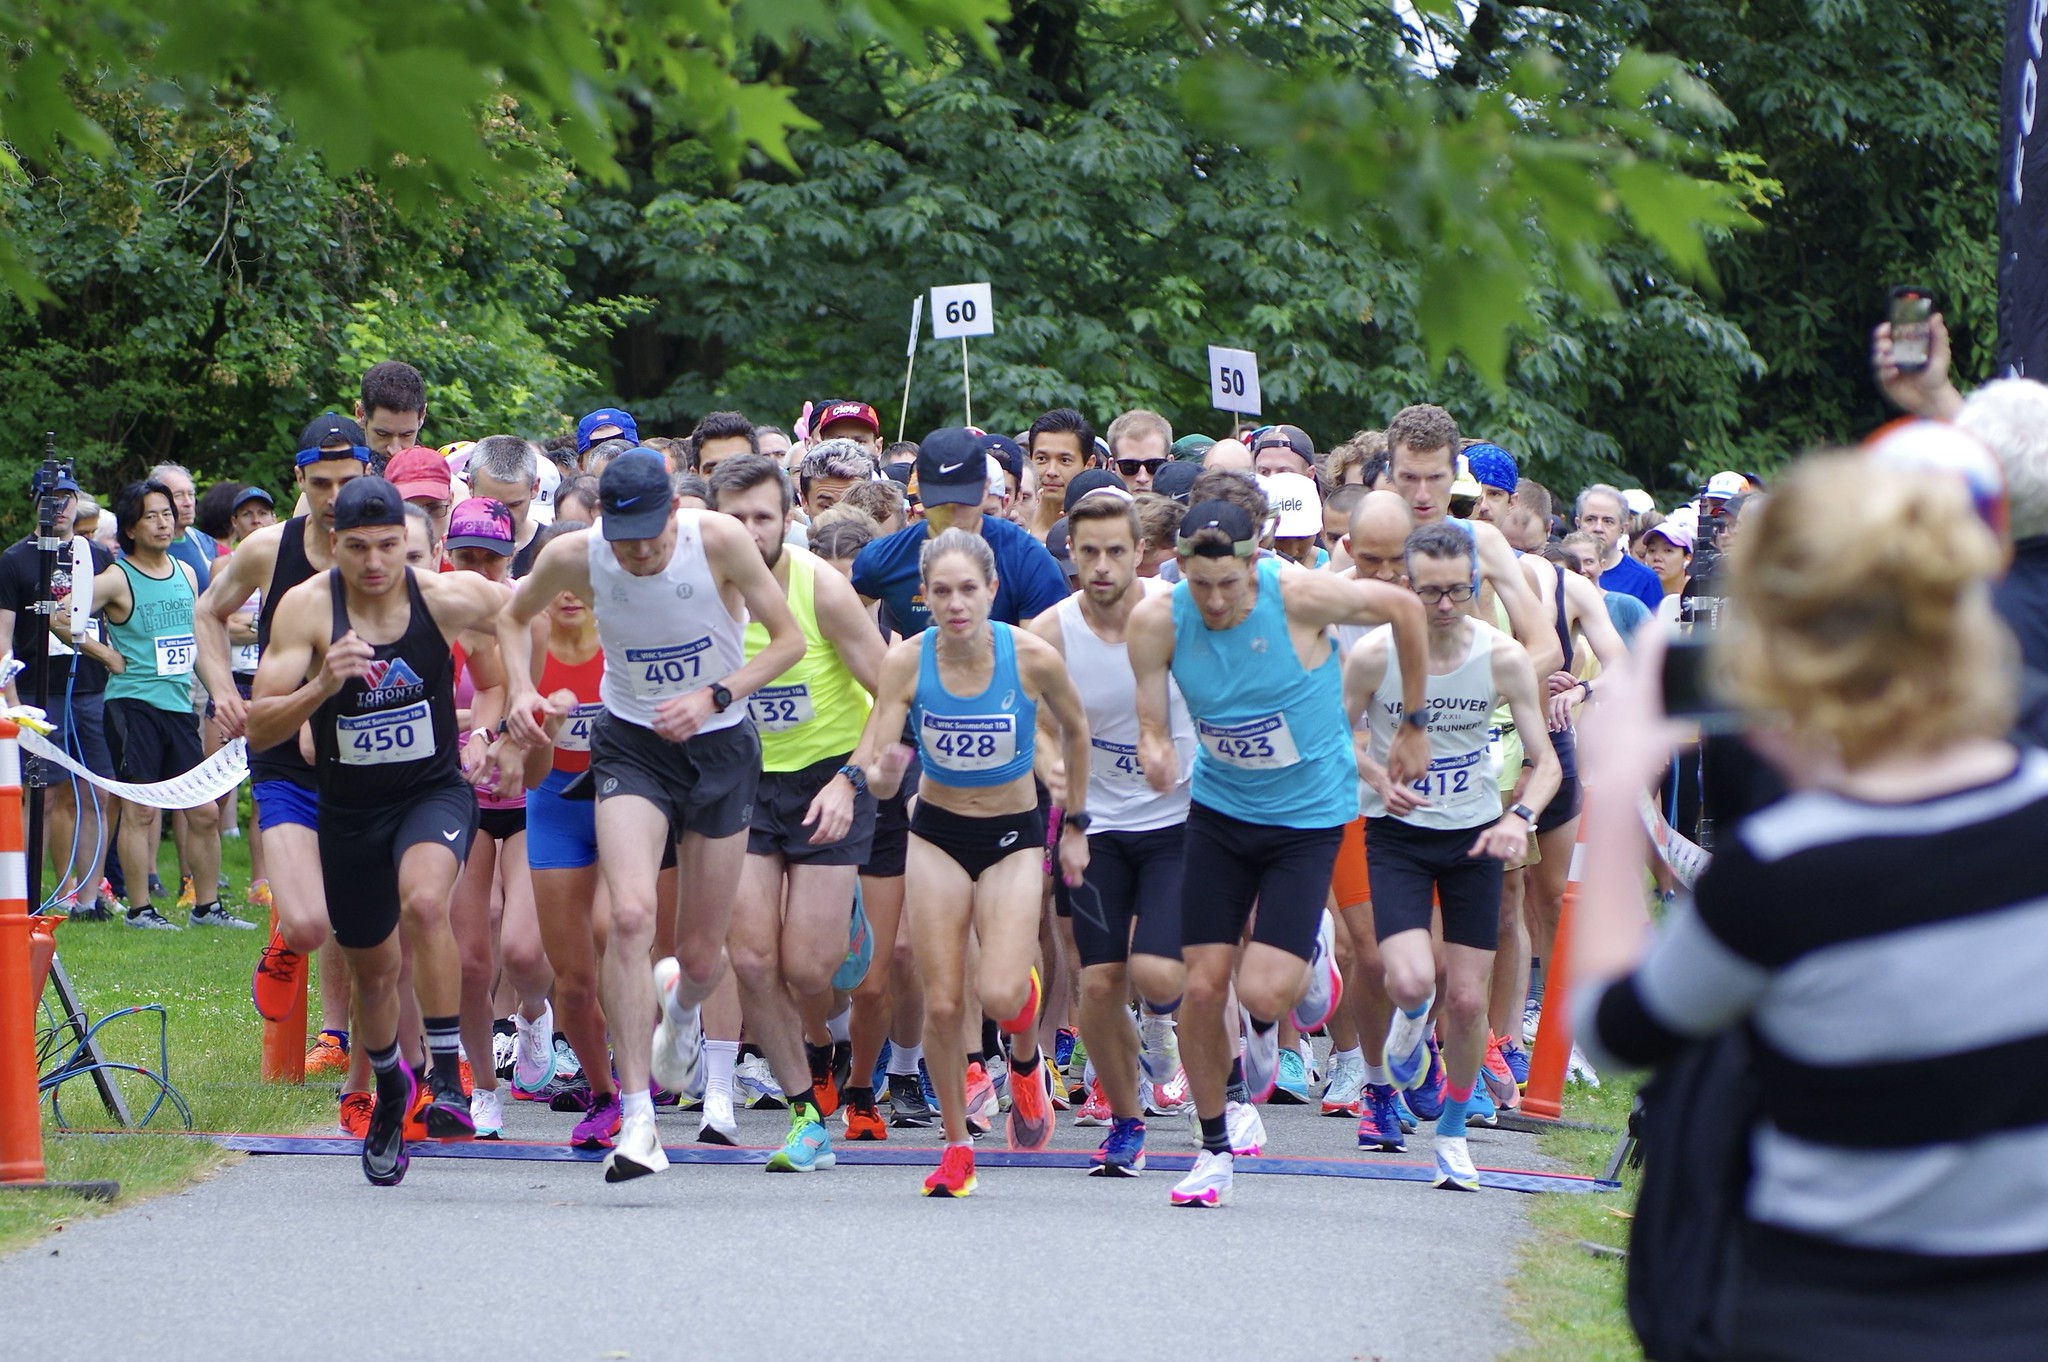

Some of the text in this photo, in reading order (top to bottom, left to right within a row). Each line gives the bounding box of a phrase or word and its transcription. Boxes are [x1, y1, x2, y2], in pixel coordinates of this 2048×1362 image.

[945, 299, 976, 323] 60
[1220, 367, 1245, 396] 50
[1280, 498, 1302, 511] iele
[166, 647, 191, 665] 251
[645, 655, 700, 684] 407
[356, 684, 424, 702] TORONTO
[353, 724, 415, 753] 450
[936, 733, 996, 757] 428
[1217, 736, 1276, 758] 423
[1413, 770, 1469, 796] 412
